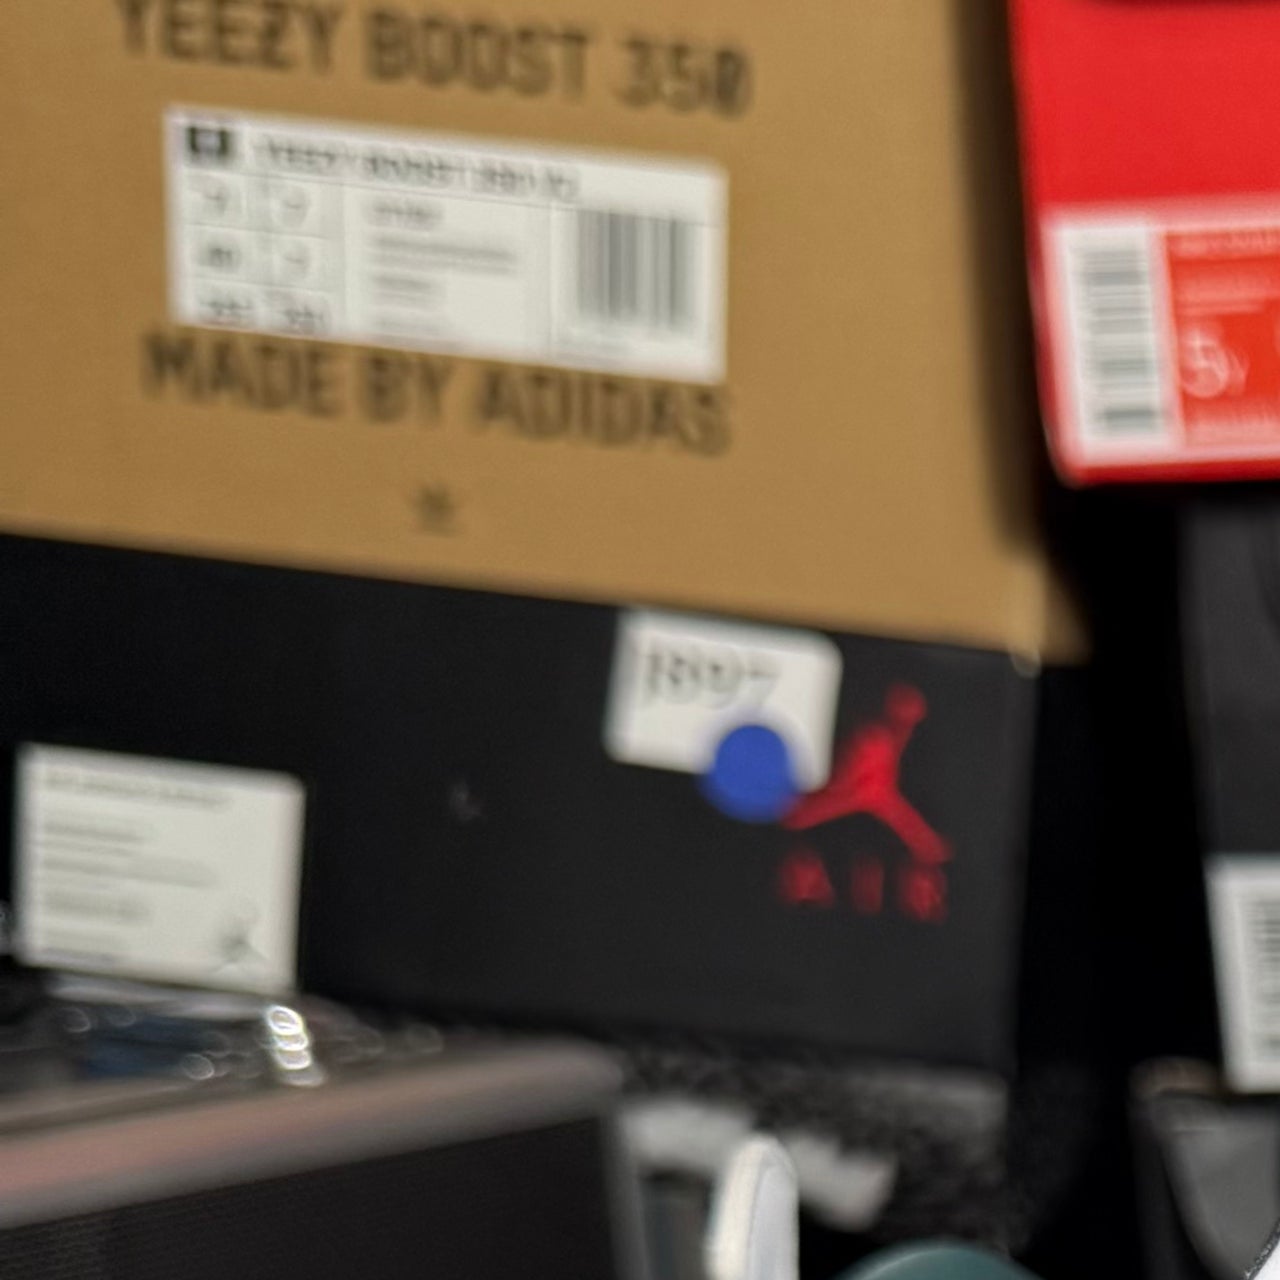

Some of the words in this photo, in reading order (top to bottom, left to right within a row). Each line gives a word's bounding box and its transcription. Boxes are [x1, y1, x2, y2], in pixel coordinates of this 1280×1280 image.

[115, 0, 342, 72] YEEZY
[364, 8, 592, 97] BOOST
[618, 34, 752, 118] 350
[144, 330, 342, 419] MADE
[354, 348, 456, 427] BY
[466, 358, 733, 460] ADIDAS
